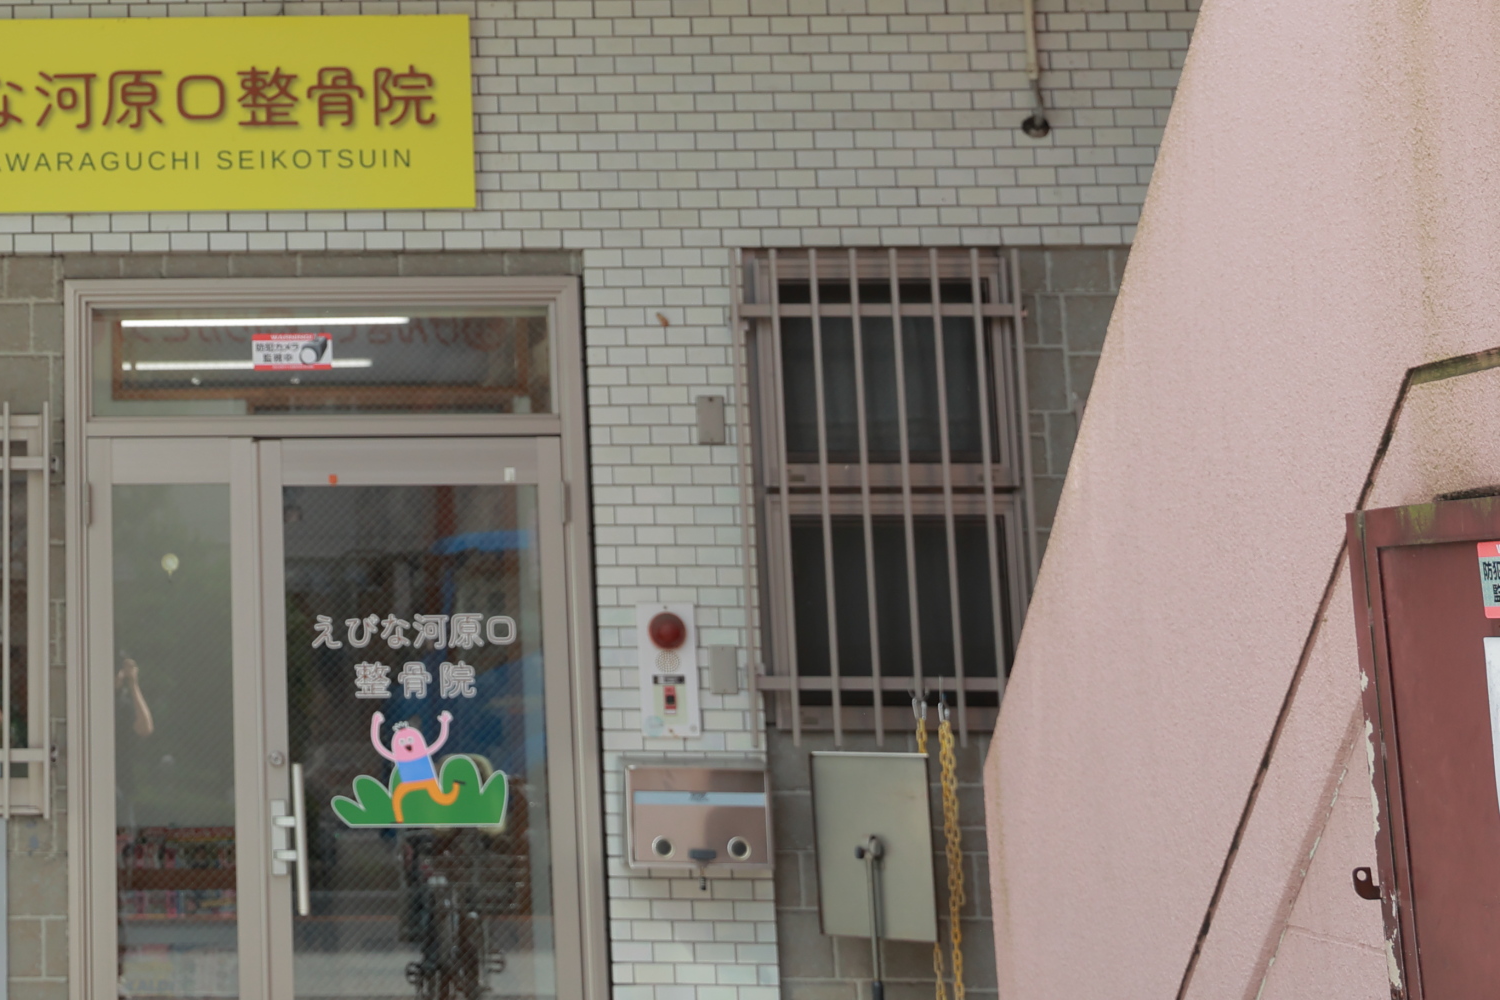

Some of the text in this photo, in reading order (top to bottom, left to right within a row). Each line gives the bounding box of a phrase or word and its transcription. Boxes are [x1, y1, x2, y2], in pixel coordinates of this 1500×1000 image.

[216, 148, 413, 171] SEIKOTSUIN
[311, 612, 518, 650] えびな河原口
[353, 660, 478, 700] 整骨院
